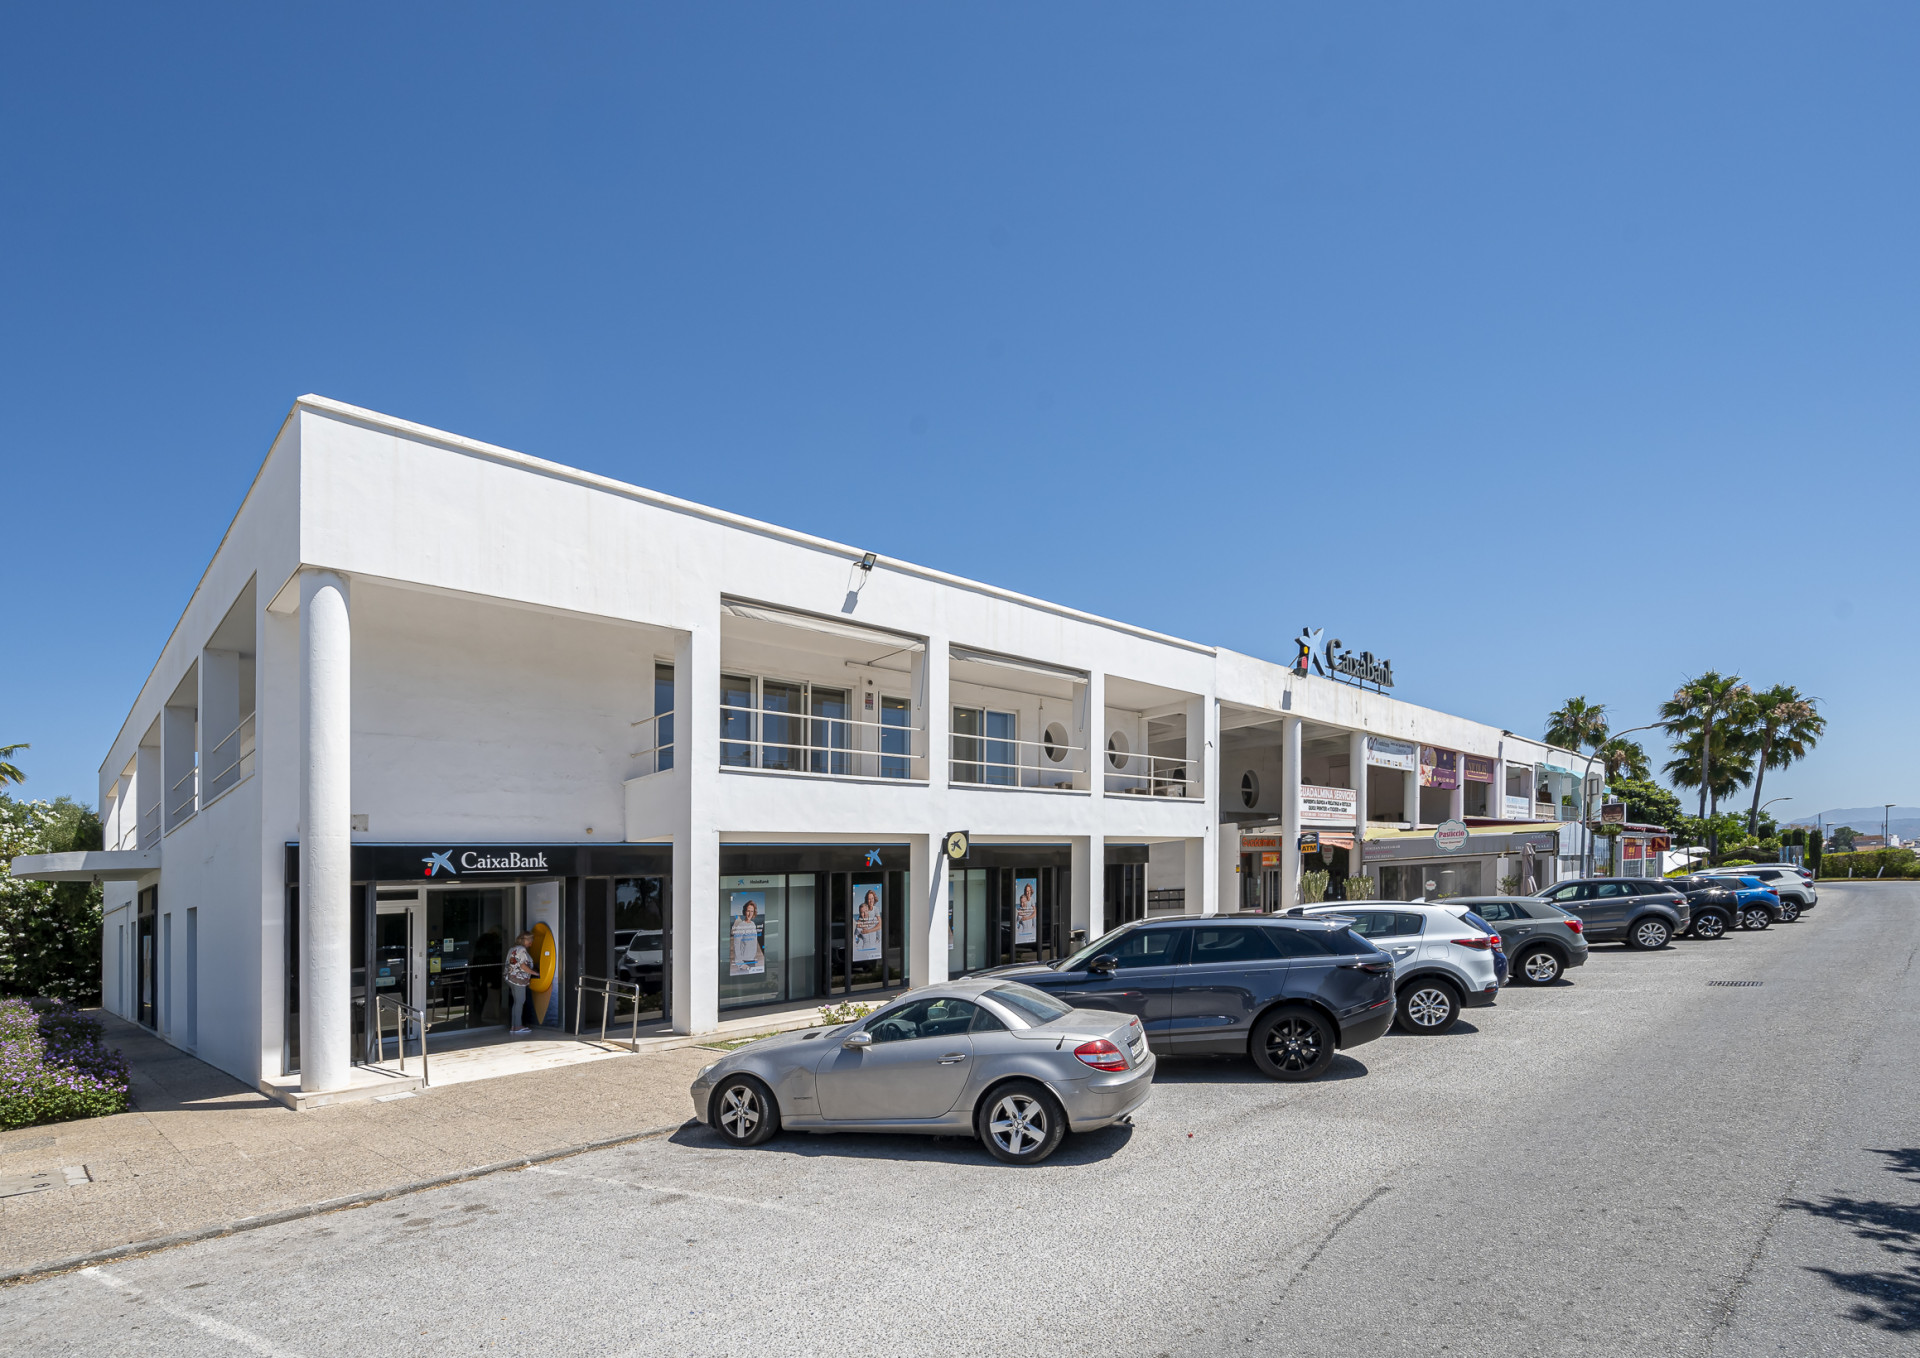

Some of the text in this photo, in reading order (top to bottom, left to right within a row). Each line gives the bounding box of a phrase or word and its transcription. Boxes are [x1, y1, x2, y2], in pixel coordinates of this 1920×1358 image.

[1326, 638, 1394, 687] CaixaBank
[1242, 837, 1276, 848] Guadalmina
[1654, 837, 1667, 849] N
[461, 851, 548, 869] CaixaBank
